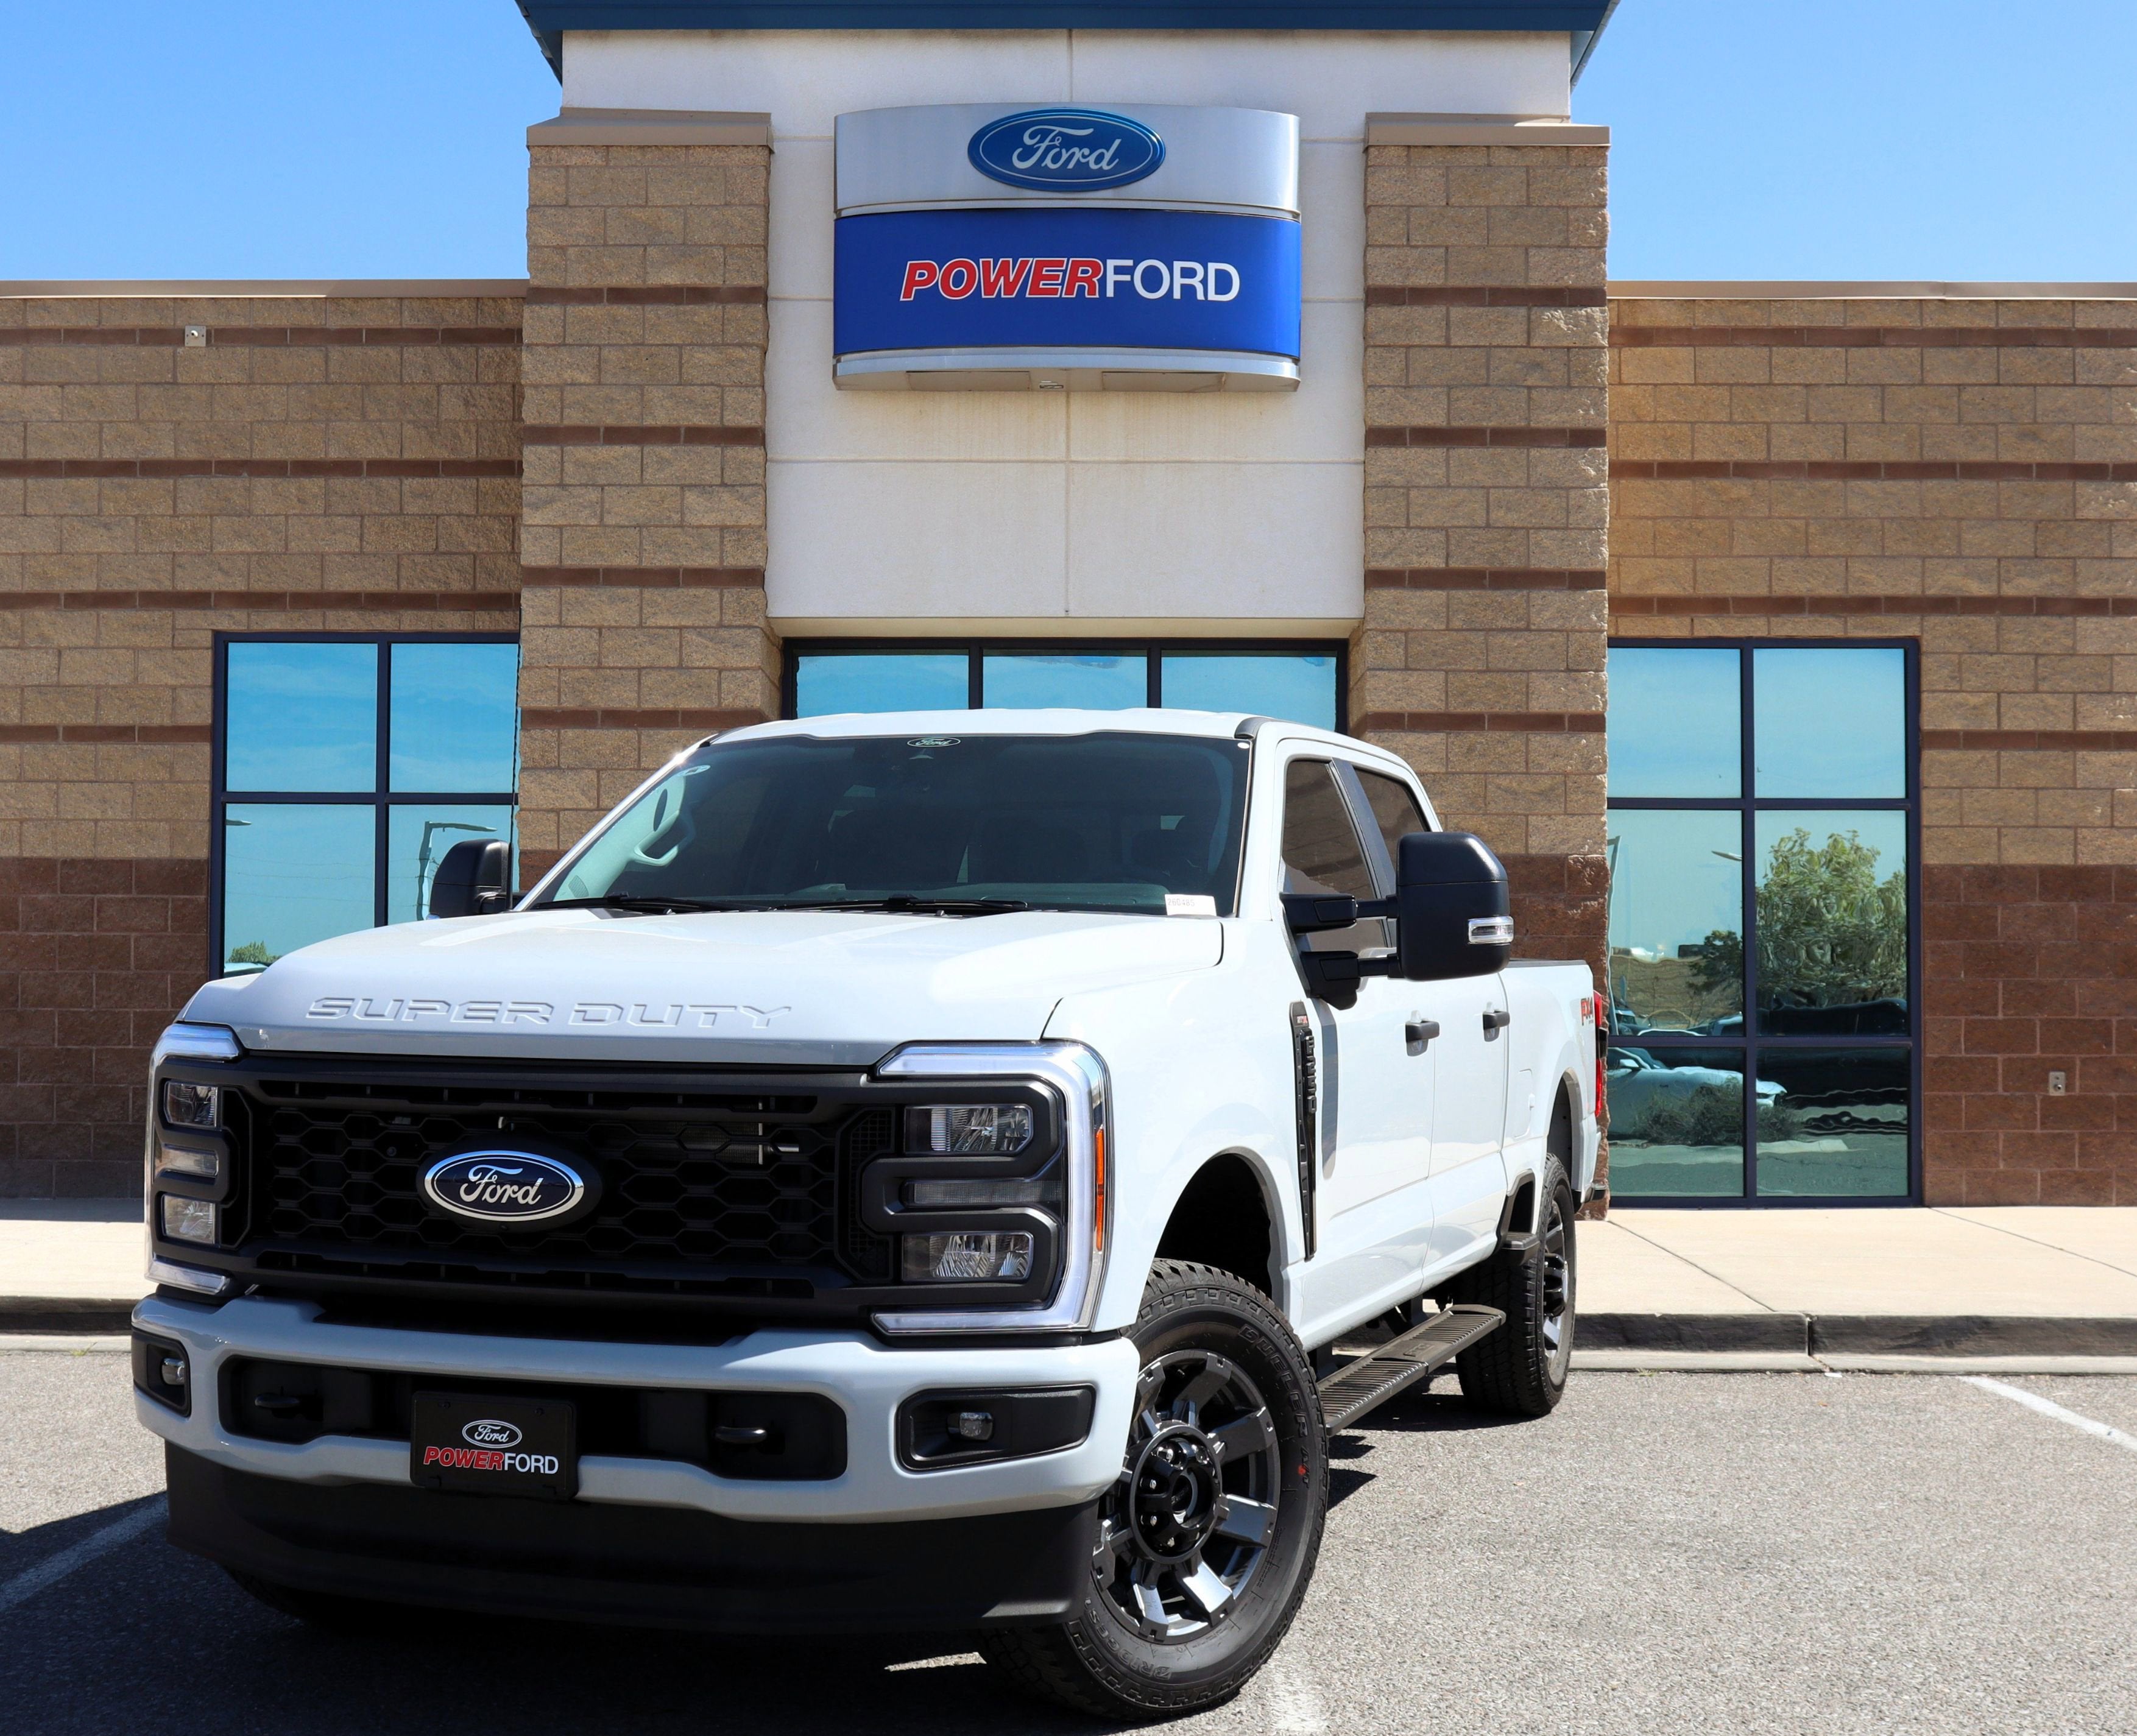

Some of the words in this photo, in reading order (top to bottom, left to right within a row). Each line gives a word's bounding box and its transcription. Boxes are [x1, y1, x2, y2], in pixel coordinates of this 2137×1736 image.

[1011, 124, 1121, 171] Ford
[915, 737, 952, 746] Ford
[306, 997, 554, 1025] SUPER
[568, 1003, 792, 1029] DUTY
[459, 1164, 544, 1205] Ford
[1237, 1323, 1309, 1438] DUELER
[473, 1424, 510, 1443] Ford
